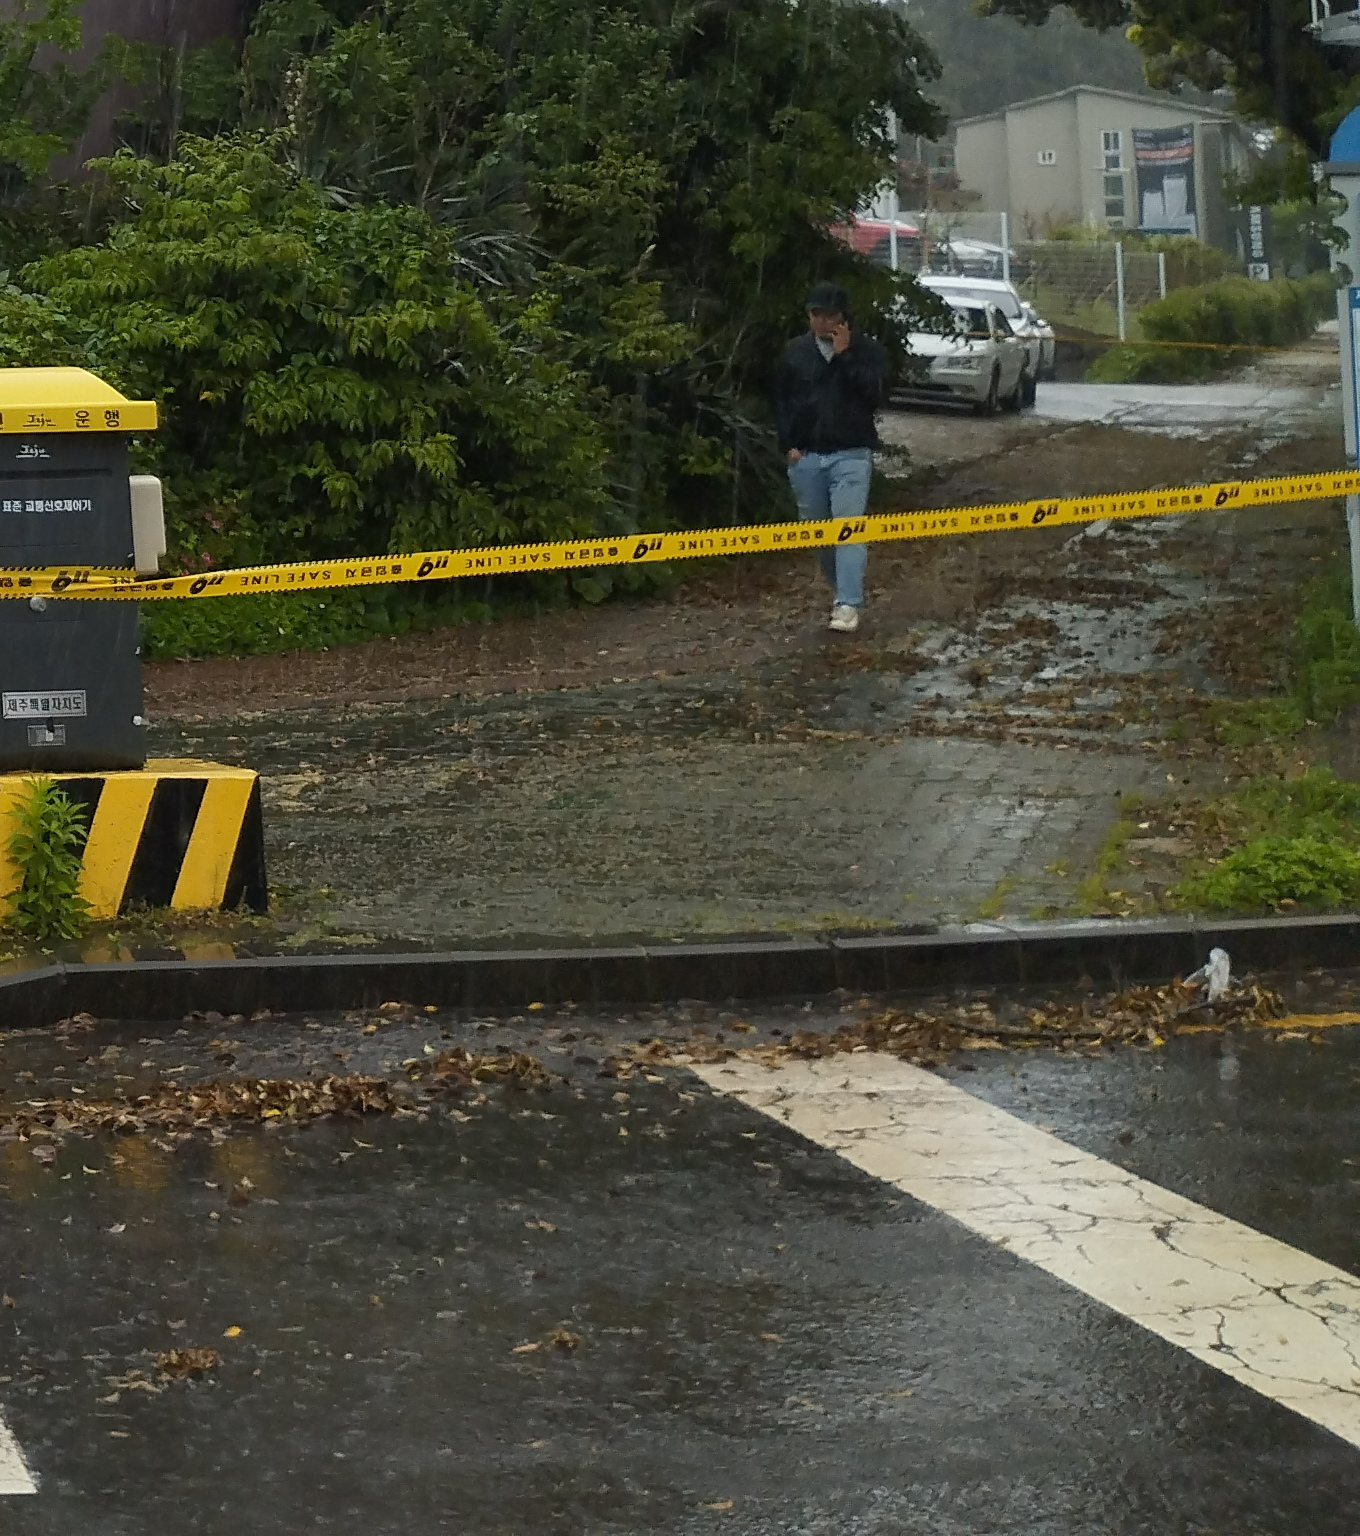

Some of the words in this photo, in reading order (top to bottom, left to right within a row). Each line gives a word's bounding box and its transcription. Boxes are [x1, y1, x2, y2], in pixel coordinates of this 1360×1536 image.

[75, 410, 120, 428] 운행
[2, 499, 22, 512] 표준
[24, 499, 92, 513] 교통신호제어기
[678, 538, 714, 551] LINE
[721, 534, 760, 547] SAFE
[465, 556, 501, 568] LINE
[508, 552, 551, 565] SAFE
[240, 574, 279, 586] LINE
[286, 570, 331, 582] SAFE
[7, 696, 82, 712] 제주특별자치도
